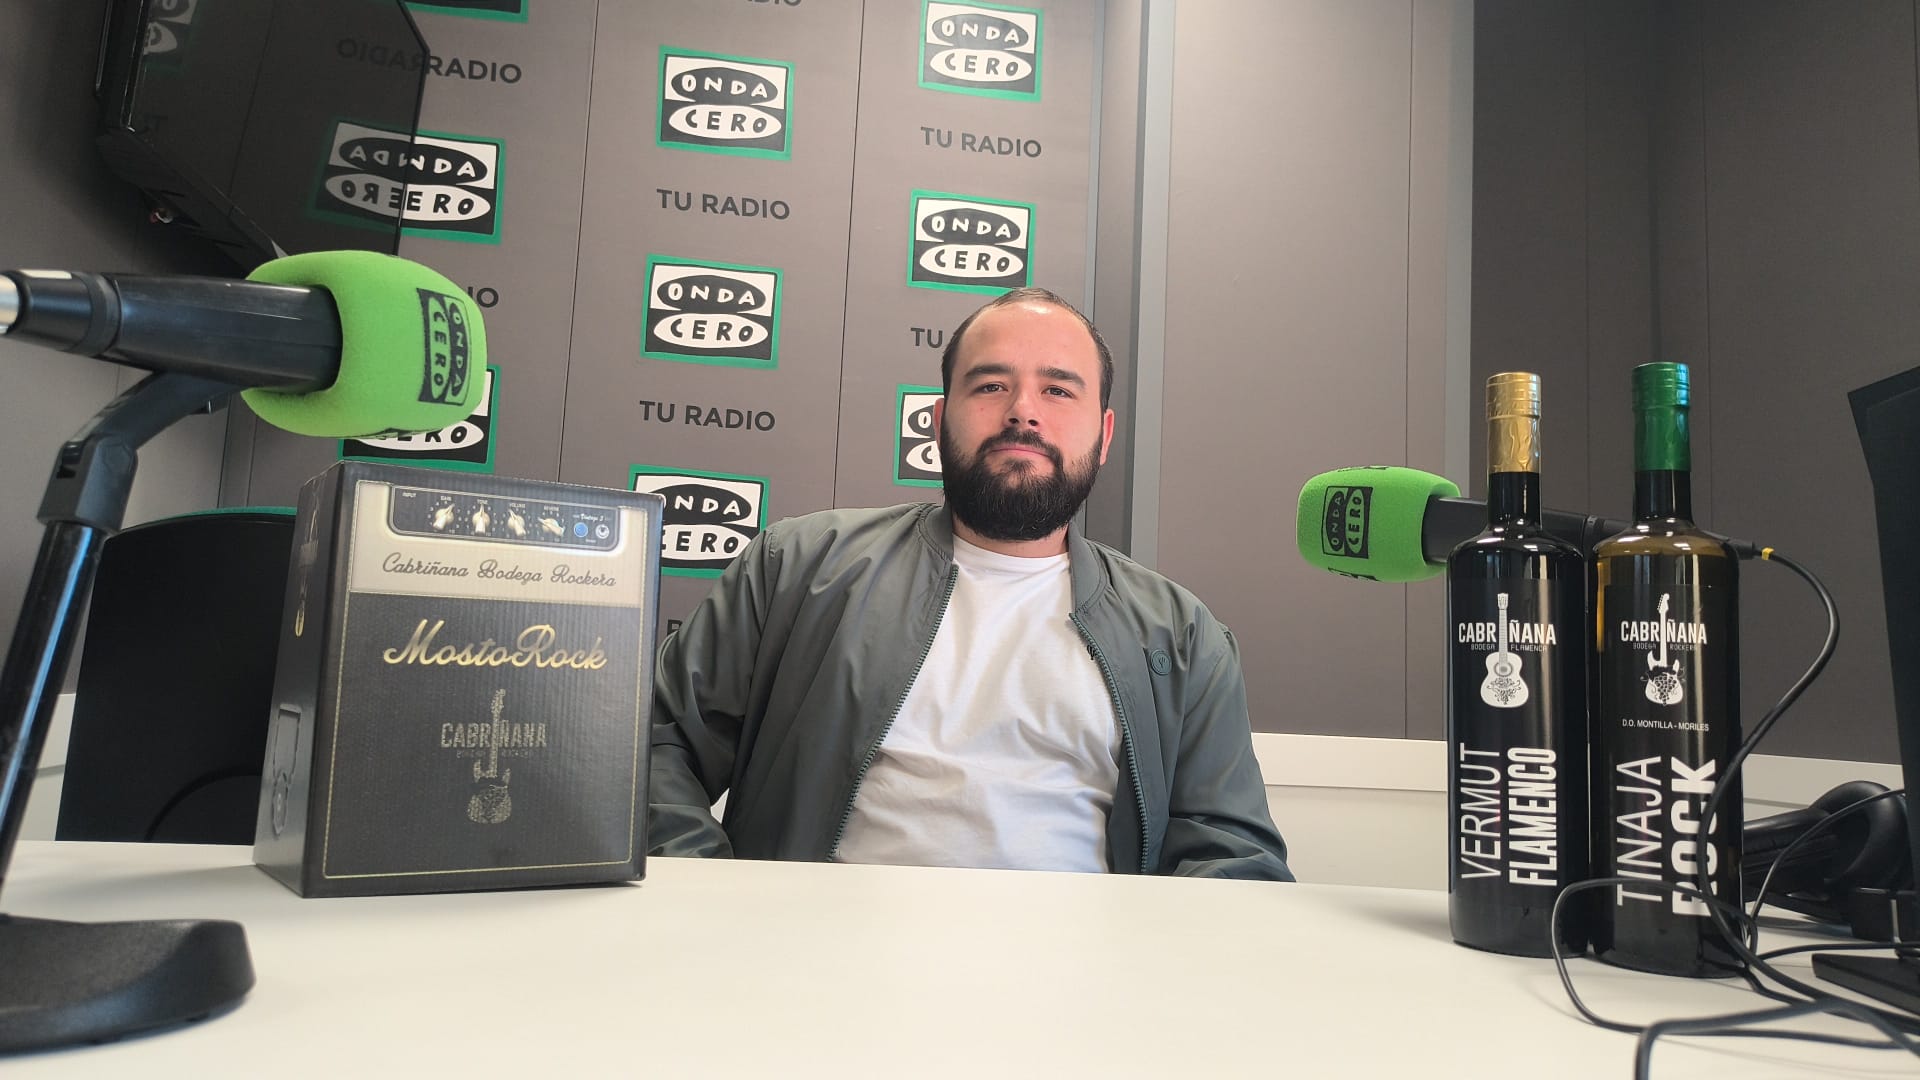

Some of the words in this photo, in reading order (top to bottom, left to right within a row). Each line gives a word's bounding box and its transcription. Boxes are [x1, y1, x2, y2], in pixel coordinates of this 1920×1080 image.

[941, 19, 1022, 44] ONDA
[426, 55, 522, 84] RADIO
[944, 53, 1019, 77] CERO
[681, 74, 769, 99] ONDA
[685, 109, 768, 133] CERO
[920, 126, 953, 149] TU
[960, 132, 1043, 159] RADIO
[410, 155, 476, 178] NDA
[406, 191, 475, 215] ERO
[657, 188, 693, 212] TU
[701, 194, 791, 220] RADIO
[931, 215, 1013, 239] ONDA
[935, 249, 1011, 273] CERO
[668, 283, 757, 307] ONDA
[670, 318, 755, 342] CERO
[910, 327, 943, 349] TU
[432, 311, 447, 387] CERO
[452, 311, 465, 388] ONDA
[639, 400, 676, 423] TU
[684, 405, 776, 431] RADIO
[662, 493, 741, 516] NDA
[1331, 497, 1342, 546] ONDA
[1348, 496, 1363, 545] CERO
[662, 529, 739, 554] ERO
[382, 552, 469, 578] Cabriñana
[477, 559, 543, 586] Bodega
[550, 564, 617, 588] Rockera
[383, 618, 608, 671] MostoRock
[1637, 719, 1673, 729] MONTILLA
[1678, 721, 1710, 732] MORILES
[1459, 742, 1501, 879] VERMUT
[1507, 746, 1557, 887] FLAMENCO
[1616, 755, 1663, 906] TINAJA
